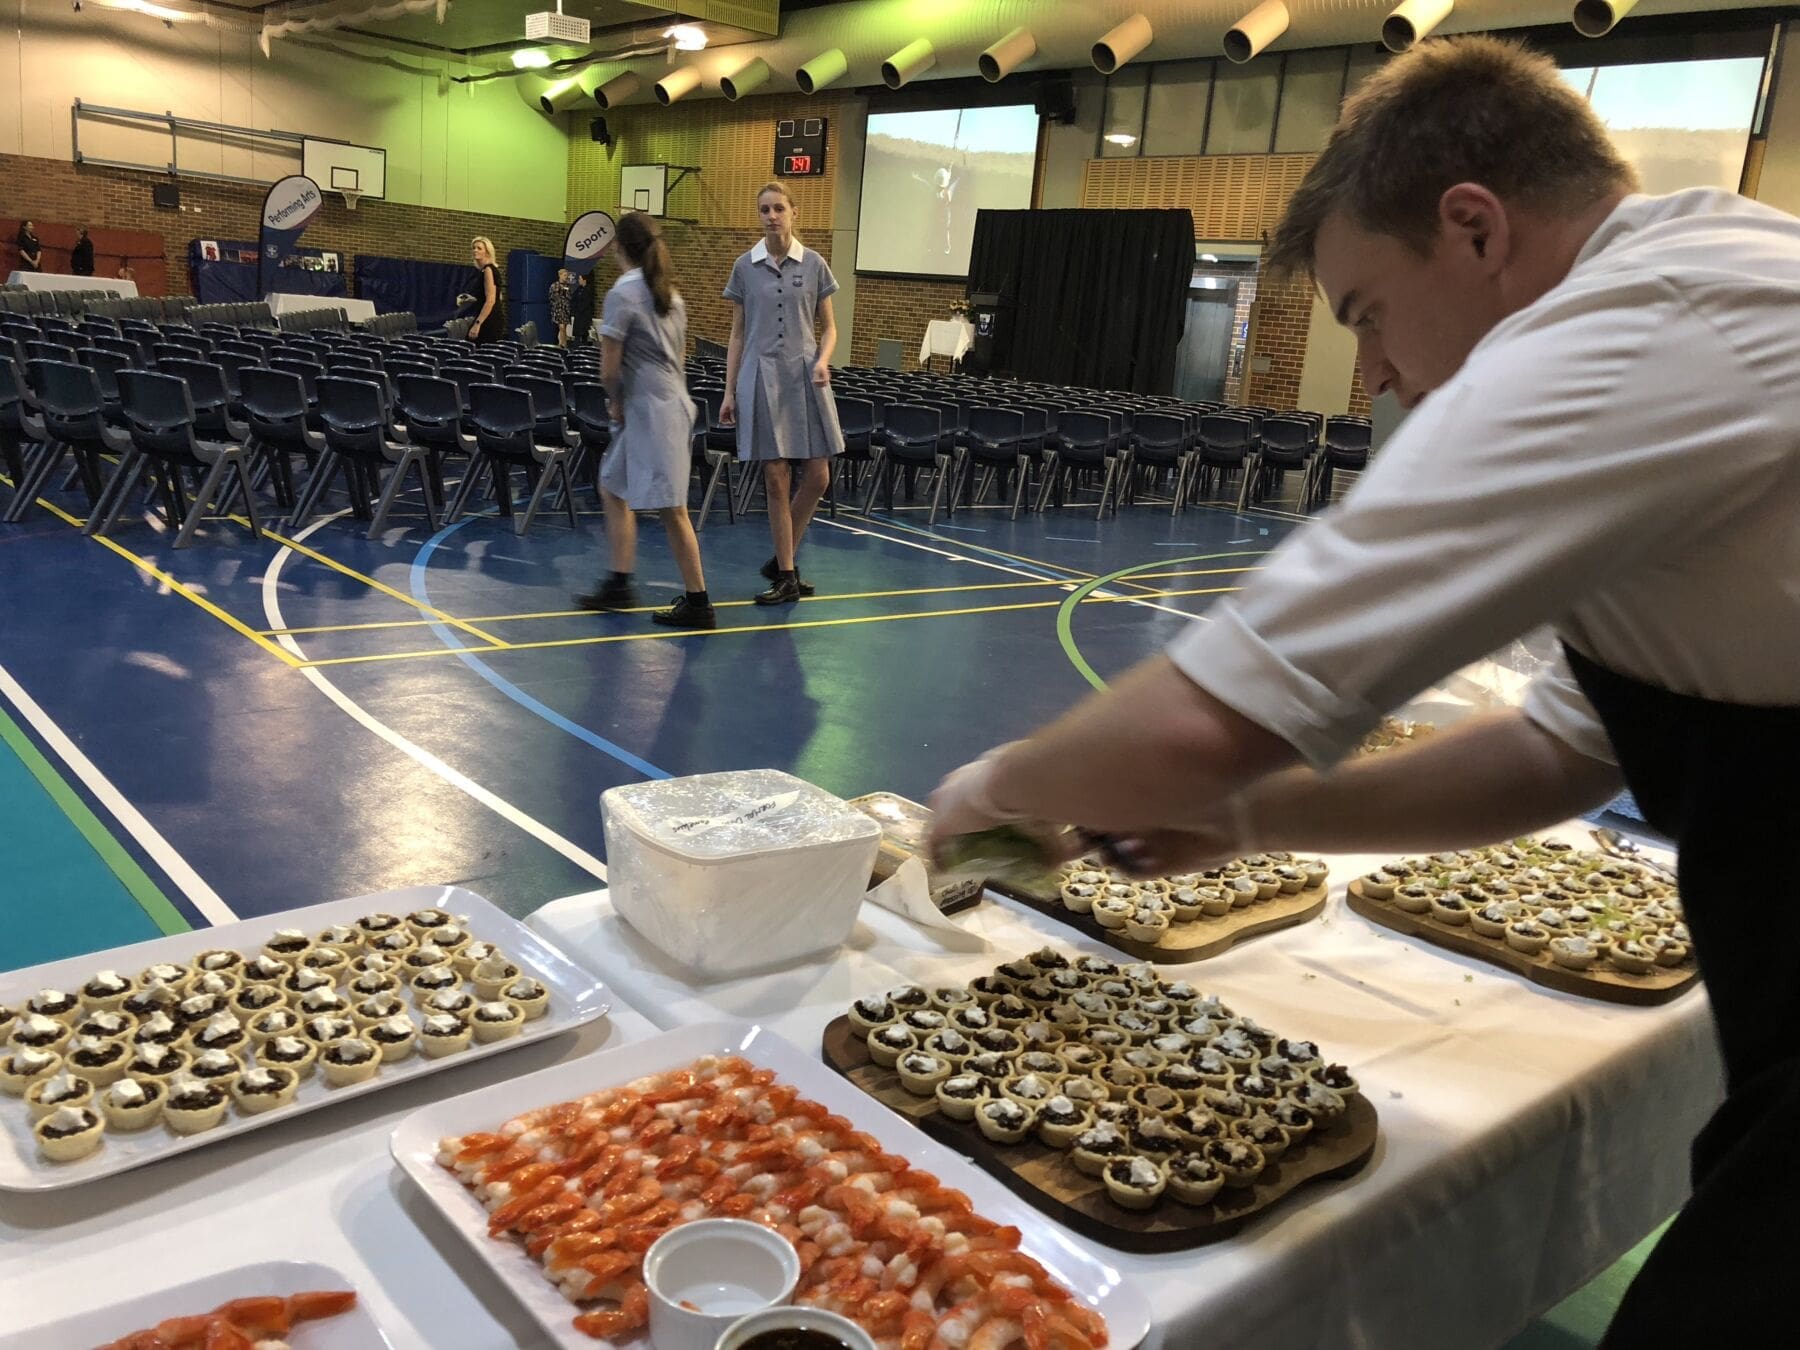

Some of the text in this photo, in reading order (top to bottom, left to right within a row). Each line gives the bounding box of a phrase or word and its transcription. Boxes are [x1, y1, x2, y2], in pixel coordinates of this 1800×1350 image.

[268, 189, 316, 225] Performing Arts
[575, 226, 608, 252] Sport
